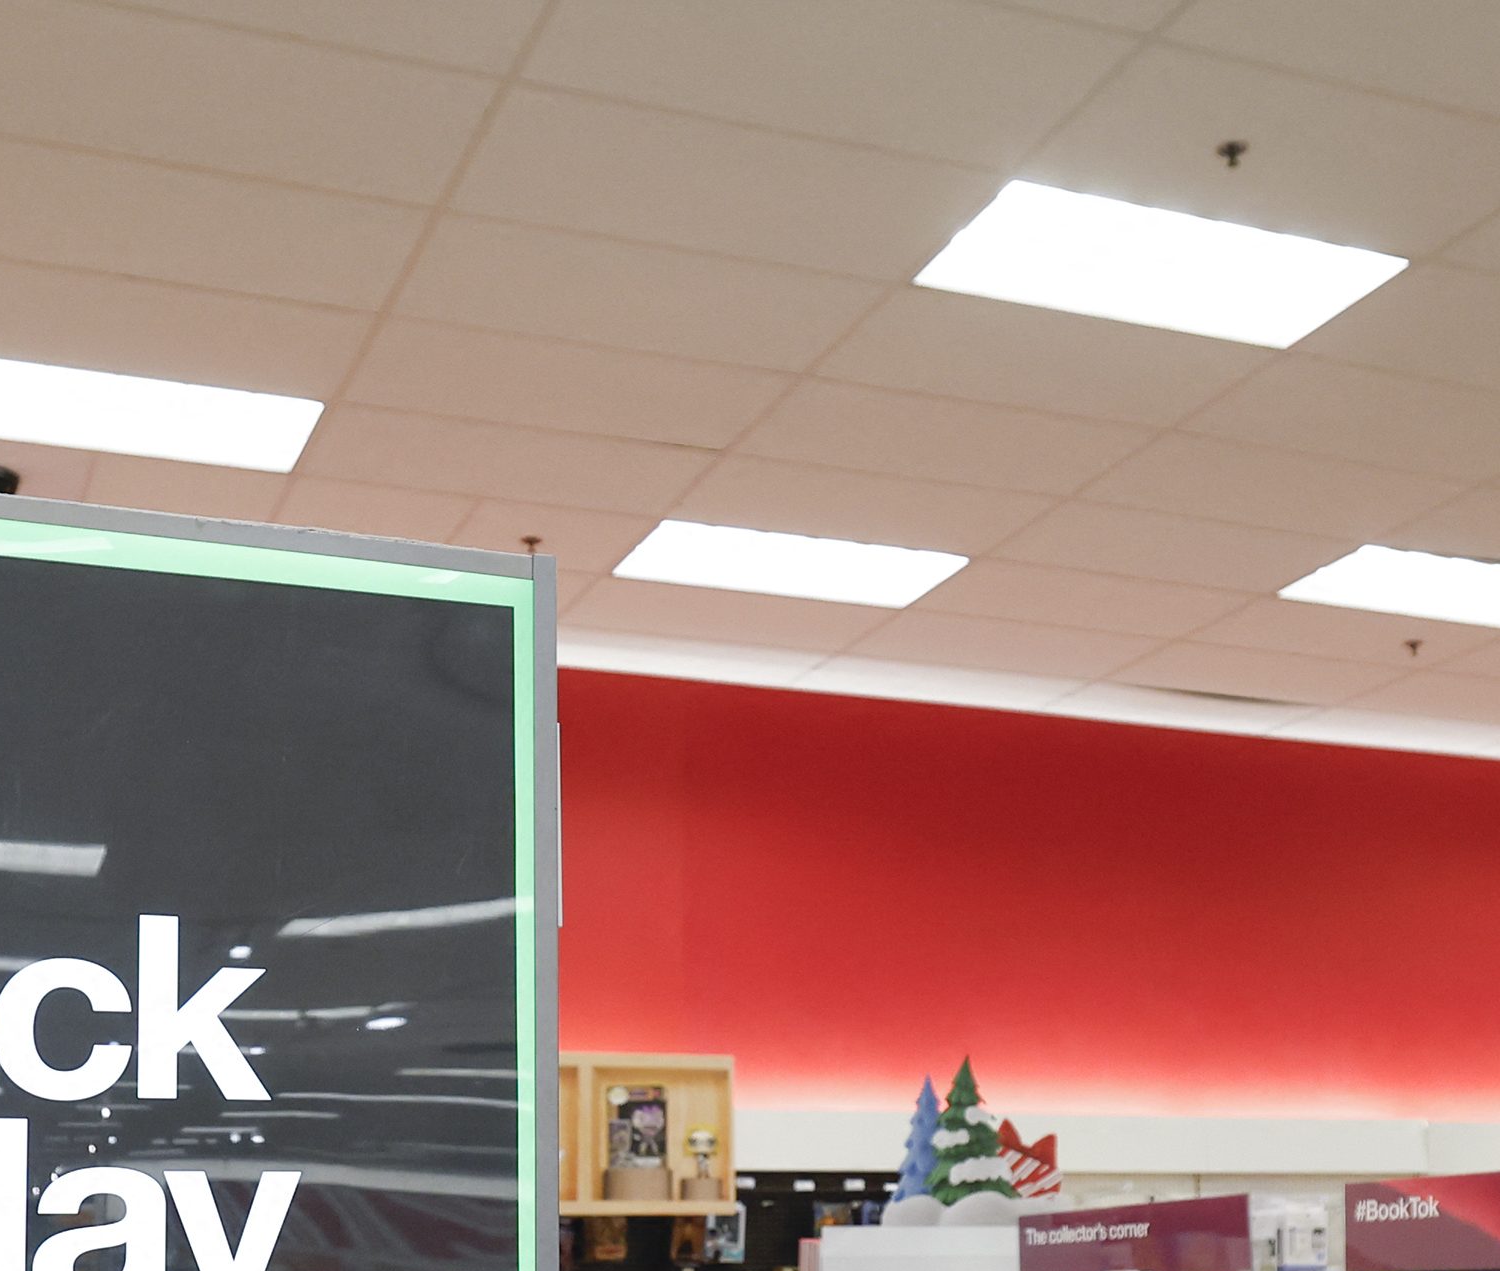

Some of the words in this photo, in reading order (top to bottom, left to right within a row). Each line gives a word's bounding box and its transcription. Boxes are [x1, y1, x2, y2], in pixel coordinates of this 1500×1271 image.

[1355, 1196, 1440, 1222] #BookTok
[1025, 1227, 1048, 1246] The
[1049, 1223, 1108, 1244] collector's
[1108, 1222, 1150, 1240] corner
